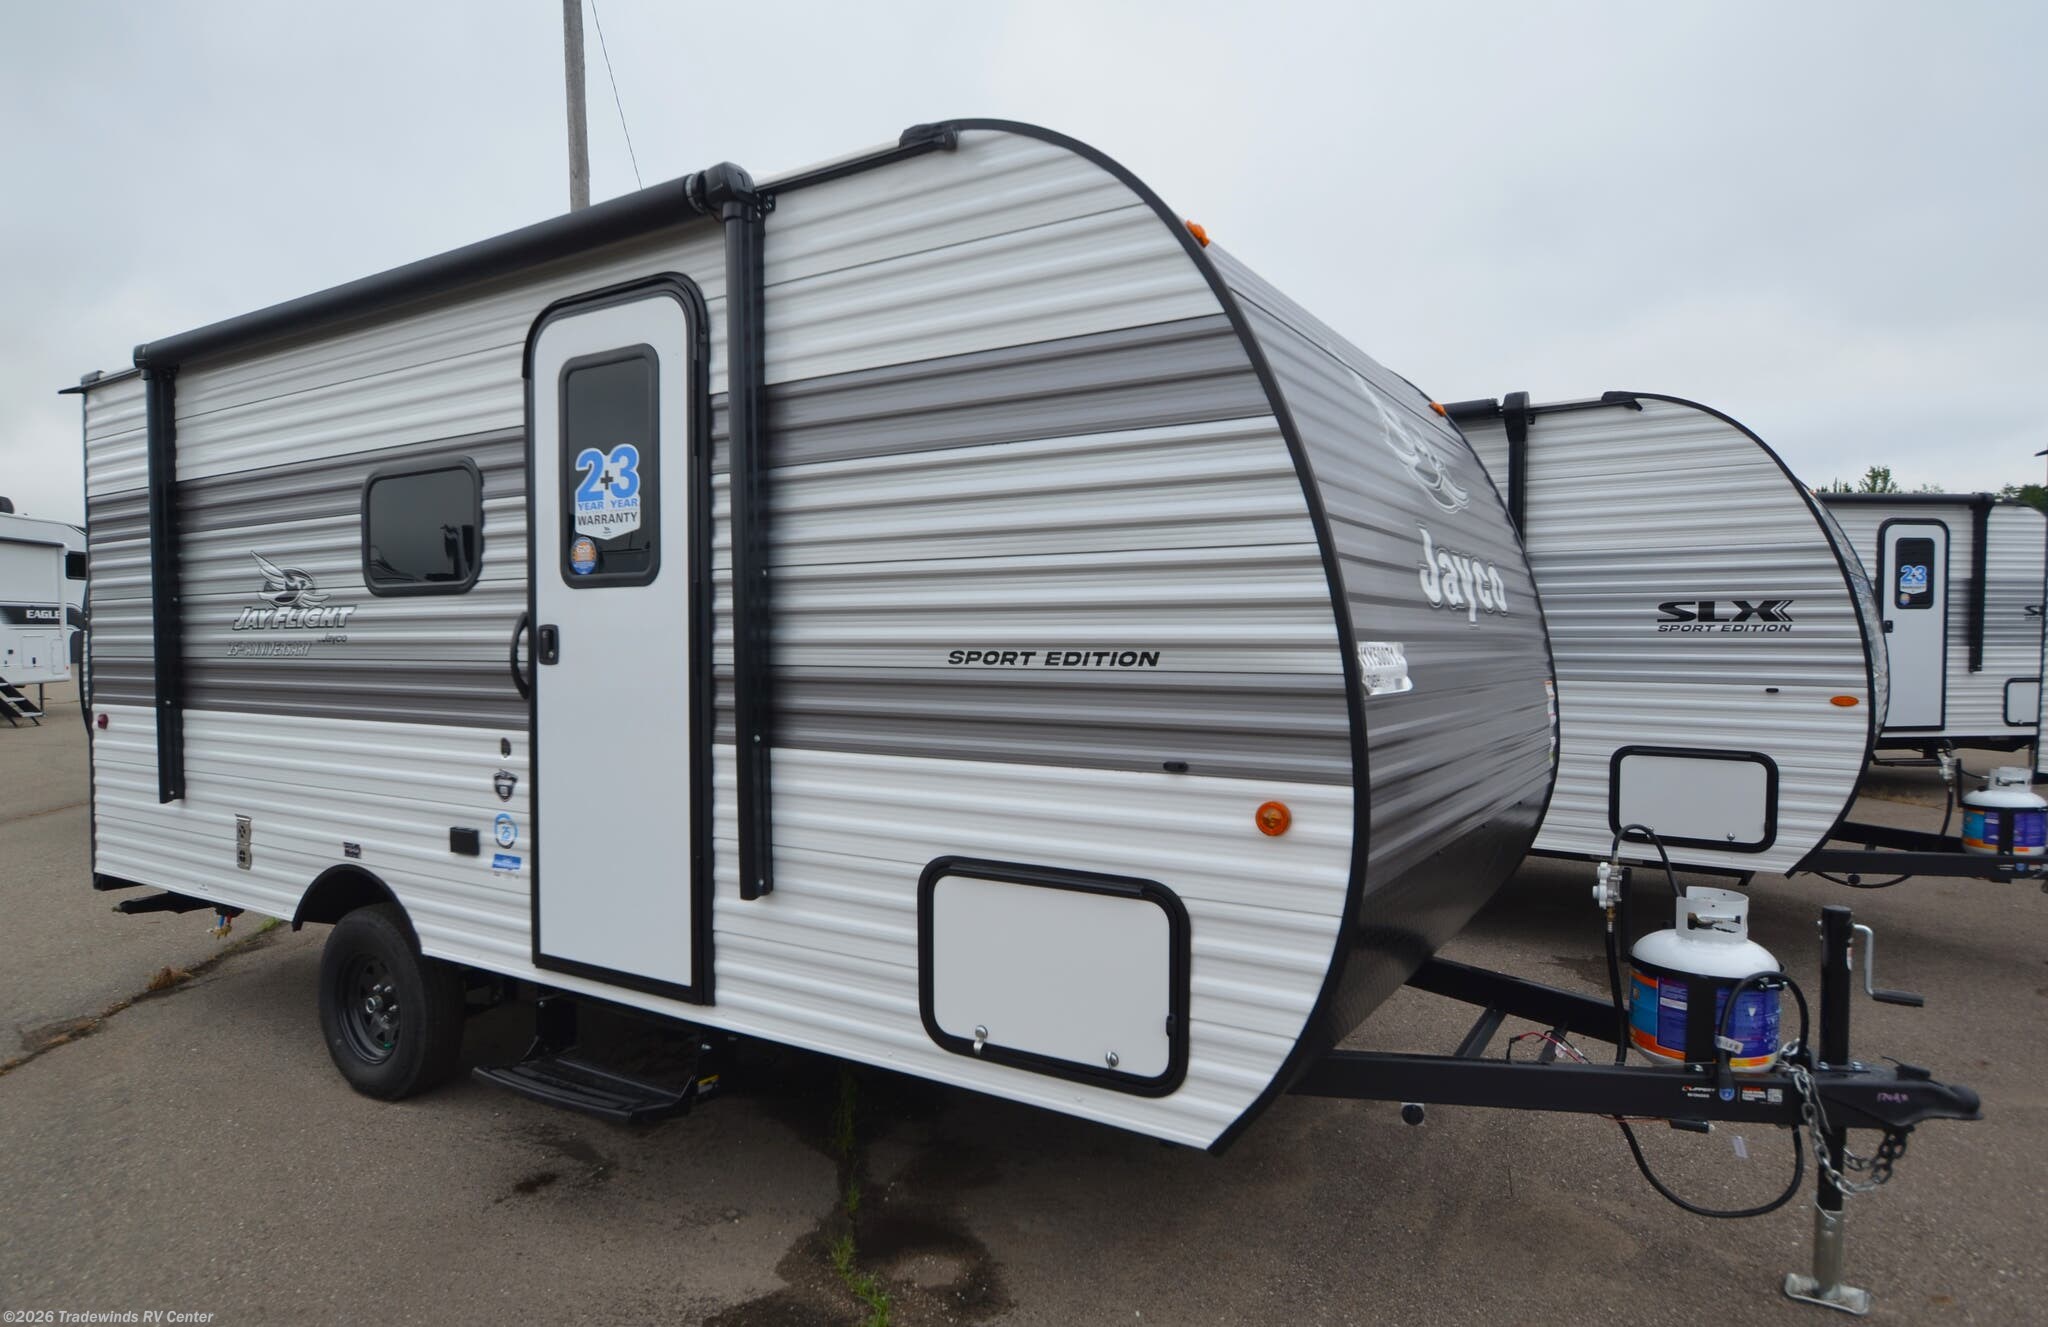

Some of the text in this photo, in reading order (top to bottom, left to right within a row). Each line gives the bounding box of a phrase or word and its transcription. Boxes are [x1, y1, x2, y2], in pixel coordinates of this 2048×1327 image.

[578, 498, 638, 512] YEAR YEAR
[577, 512, 638, 527] WARRANTY
[1417, 520, 1508, 627] Jayco
[26, 609, 61, 619] EAGLE
[270, 604, 357, 629] FLIGHT
[1657, 600, 1794, 623] SLX
[1658, 624, 1793, 633] SPORT EDITION
[948, 650, 1161, 667] SPORT EDITION
